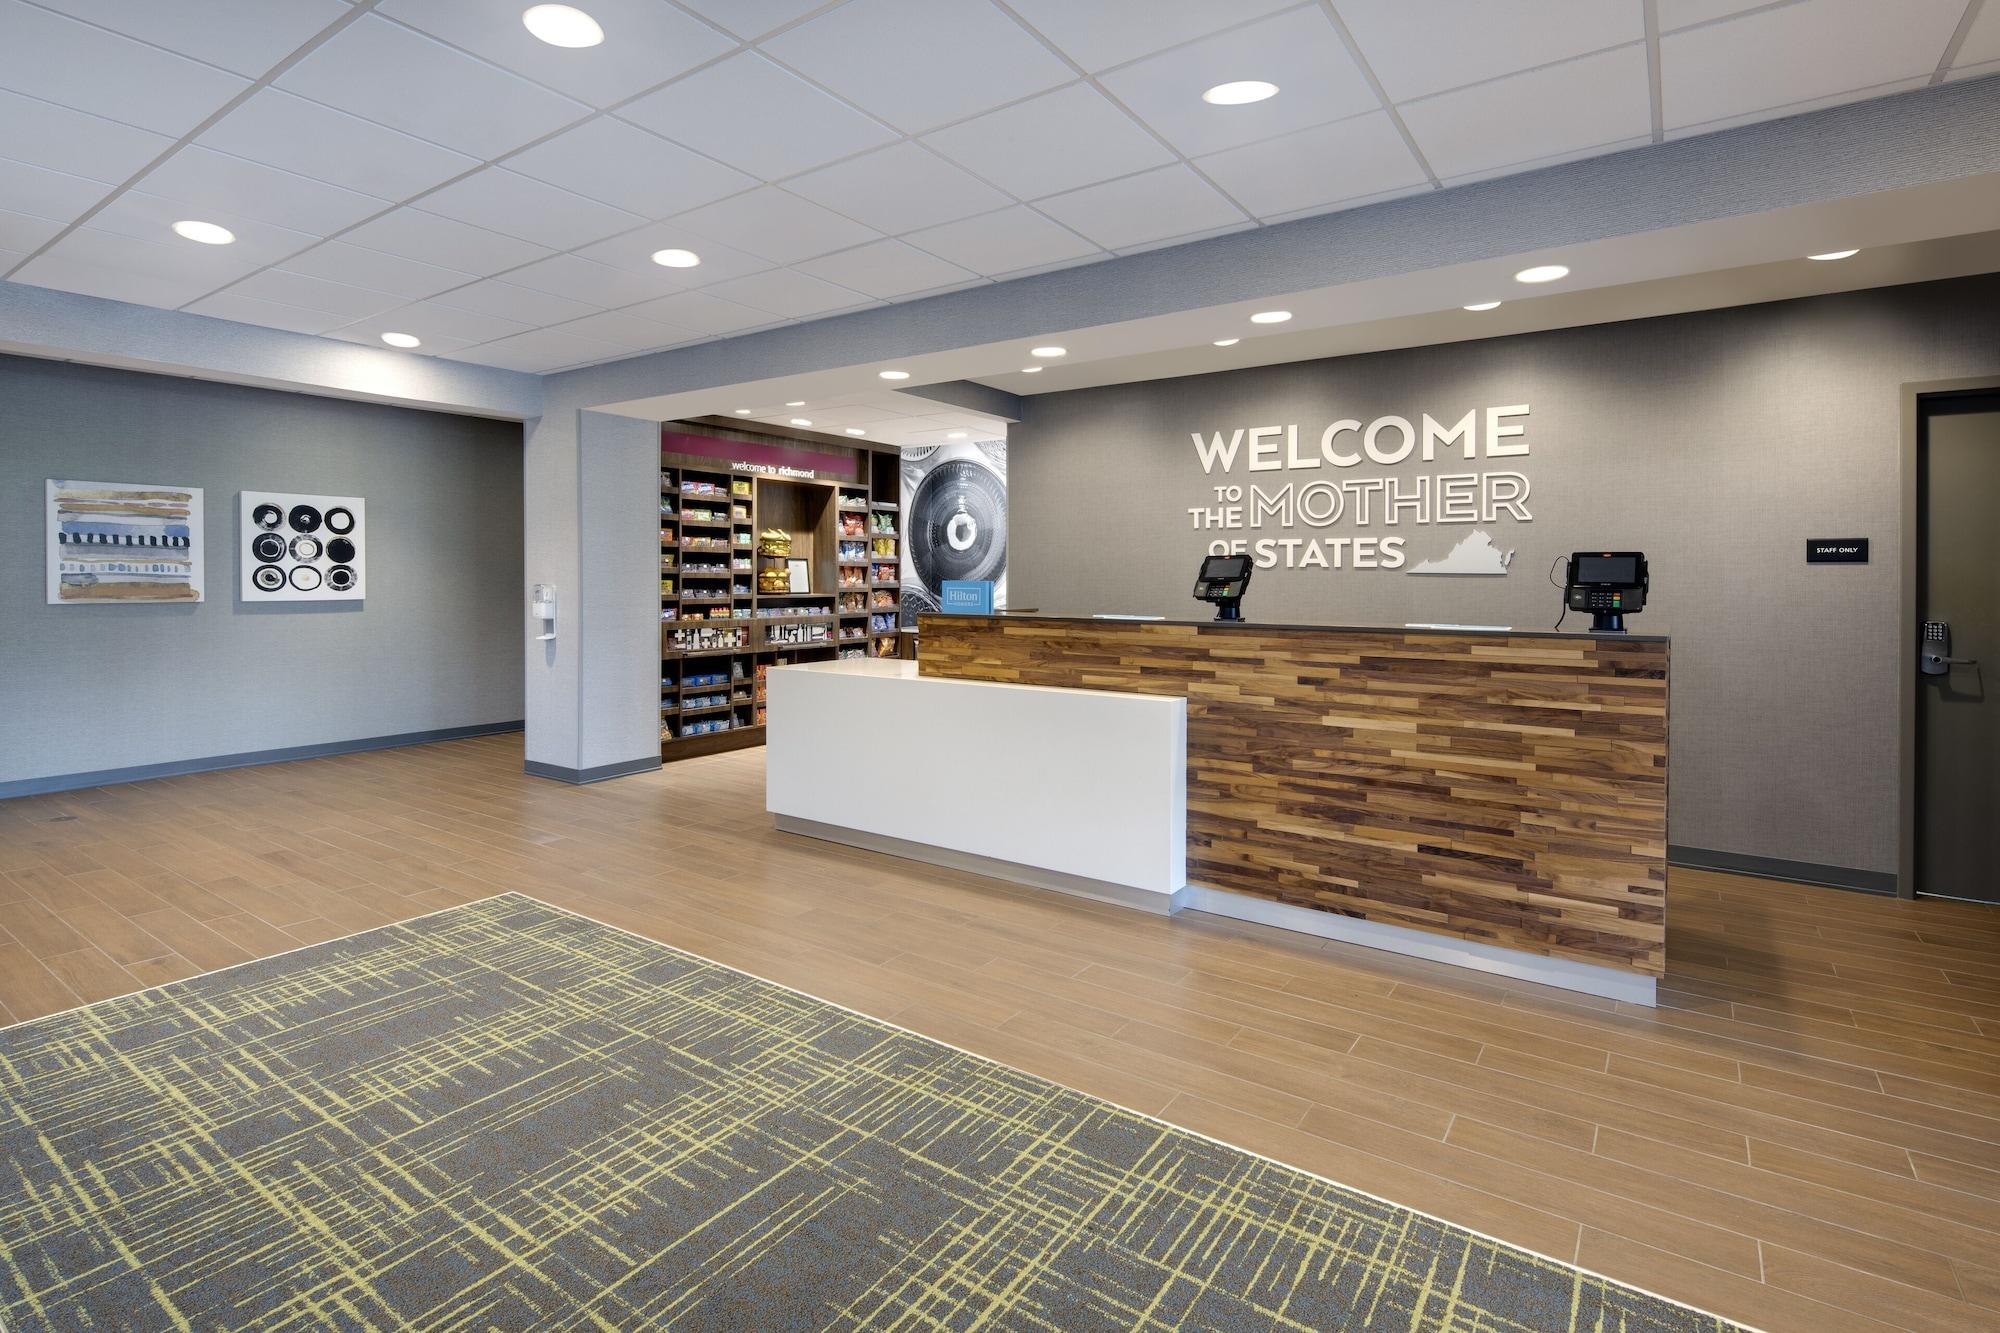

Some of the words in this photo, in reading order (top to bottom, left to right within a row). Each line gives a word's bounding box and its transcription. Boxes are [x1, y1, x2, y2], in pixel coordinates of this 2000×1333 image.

[1190, 404, 1530, 474] WELCOME
[732, 461, 766, 472] welcome
[767, 464, 776, 474] to
[778, 465, 815, 478] richmond
[1188, 506, 1243, 529] THE
[1250, 471, 1533, 527] MOTHER
[1213, 485, 1243, 503] TO
[1254, 536, 1406, 570] STATES
[949, 590, 978, 600] Hilton
